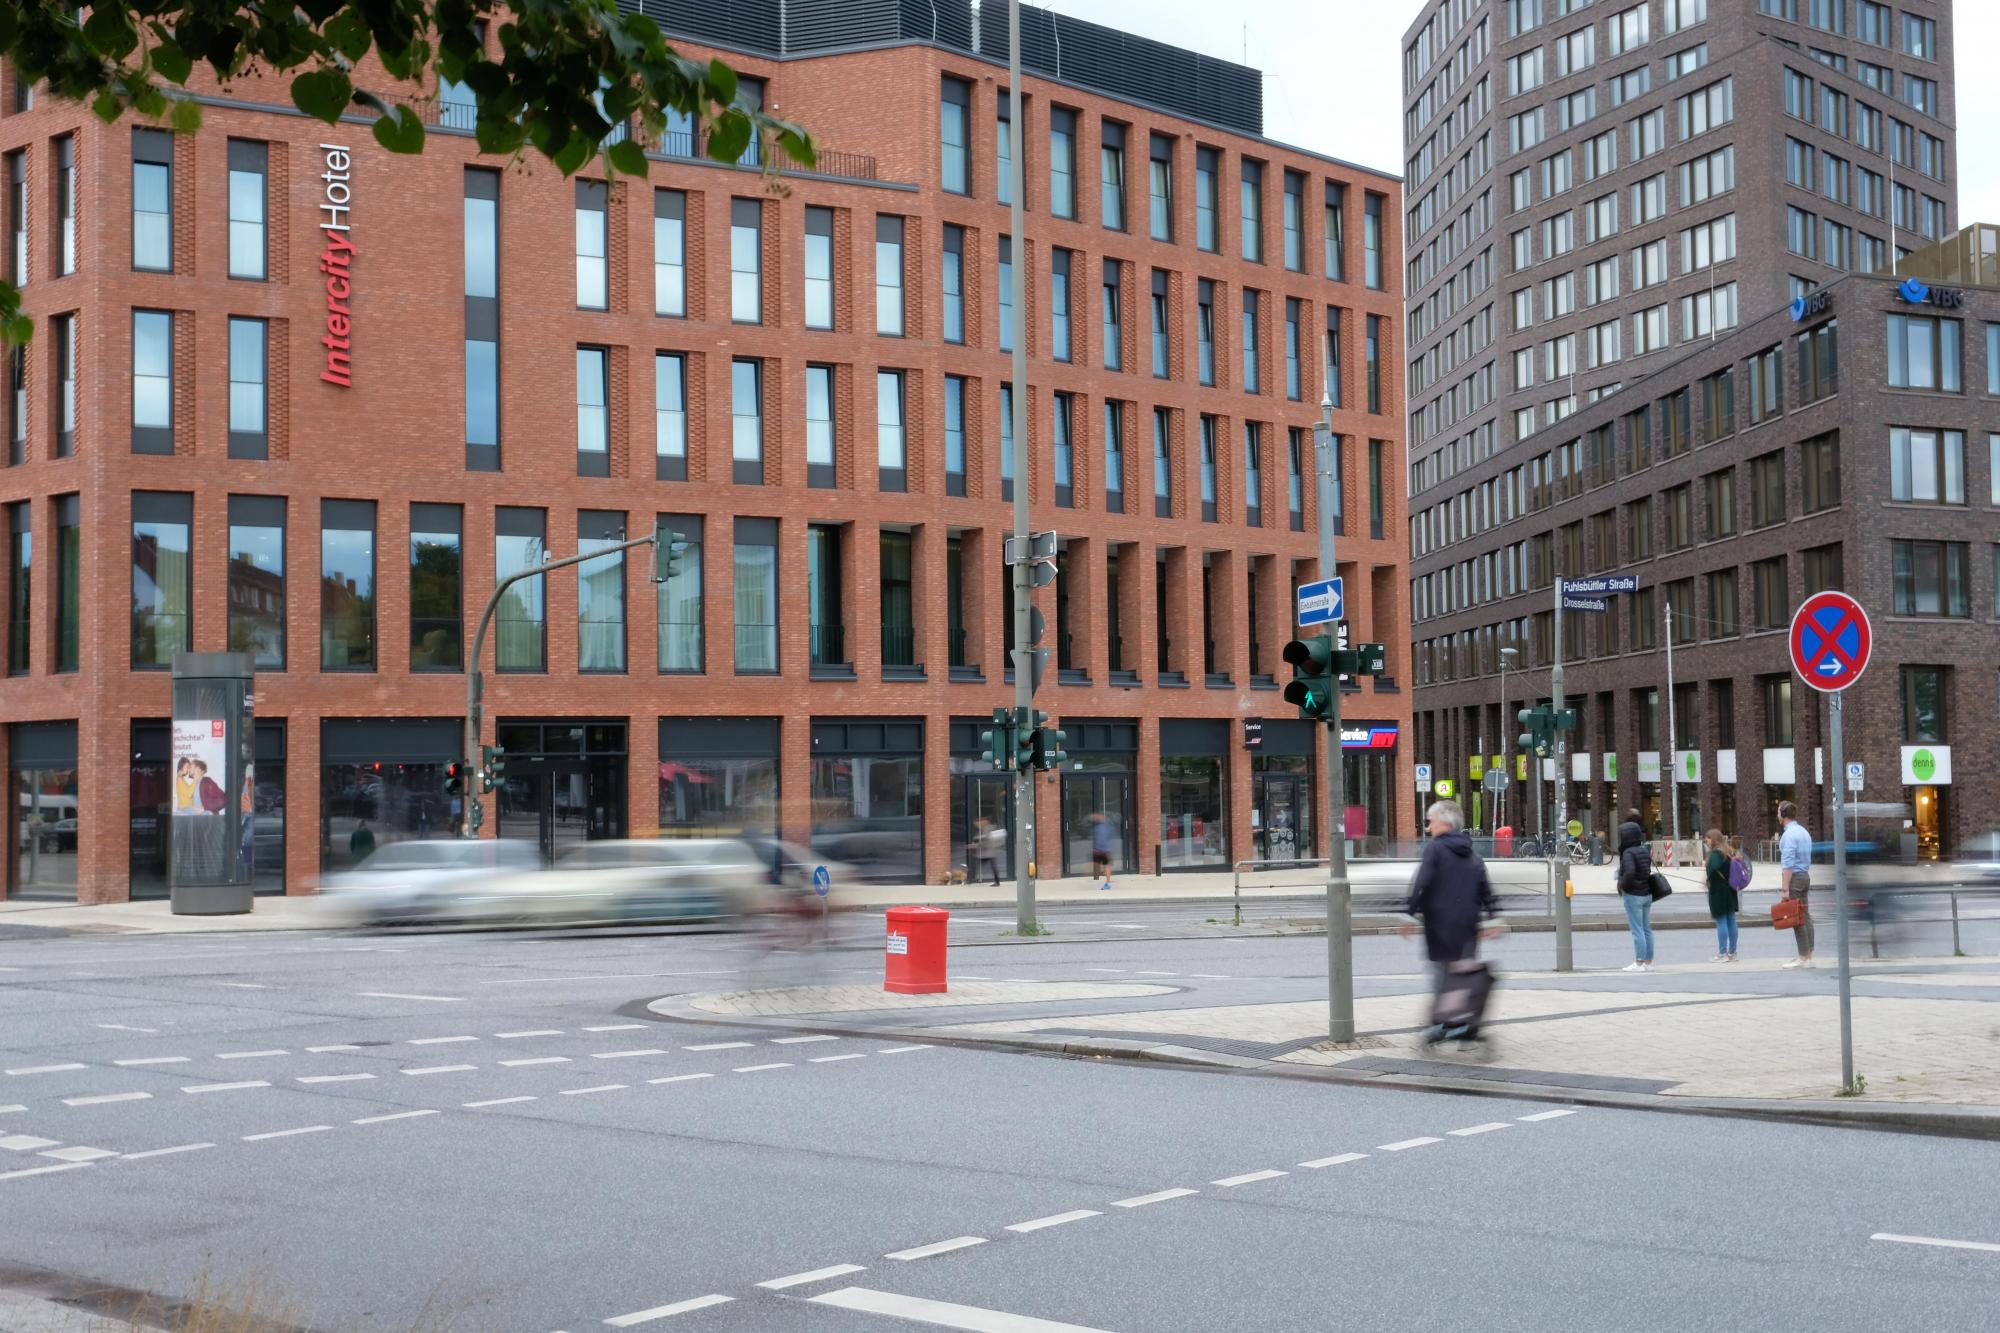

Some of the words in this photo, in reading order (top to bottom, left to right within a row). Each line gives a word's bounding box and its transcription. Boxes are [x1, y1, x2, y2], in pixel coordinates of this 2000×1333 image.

[320, 143, 356, 388] IntercityHotel
[1563, 580, 1607, 592] Fuhlsbüttler
[1608, 578, 1634, 589] Straße
[1563, 597, 1605, 610] Drosselstraße
